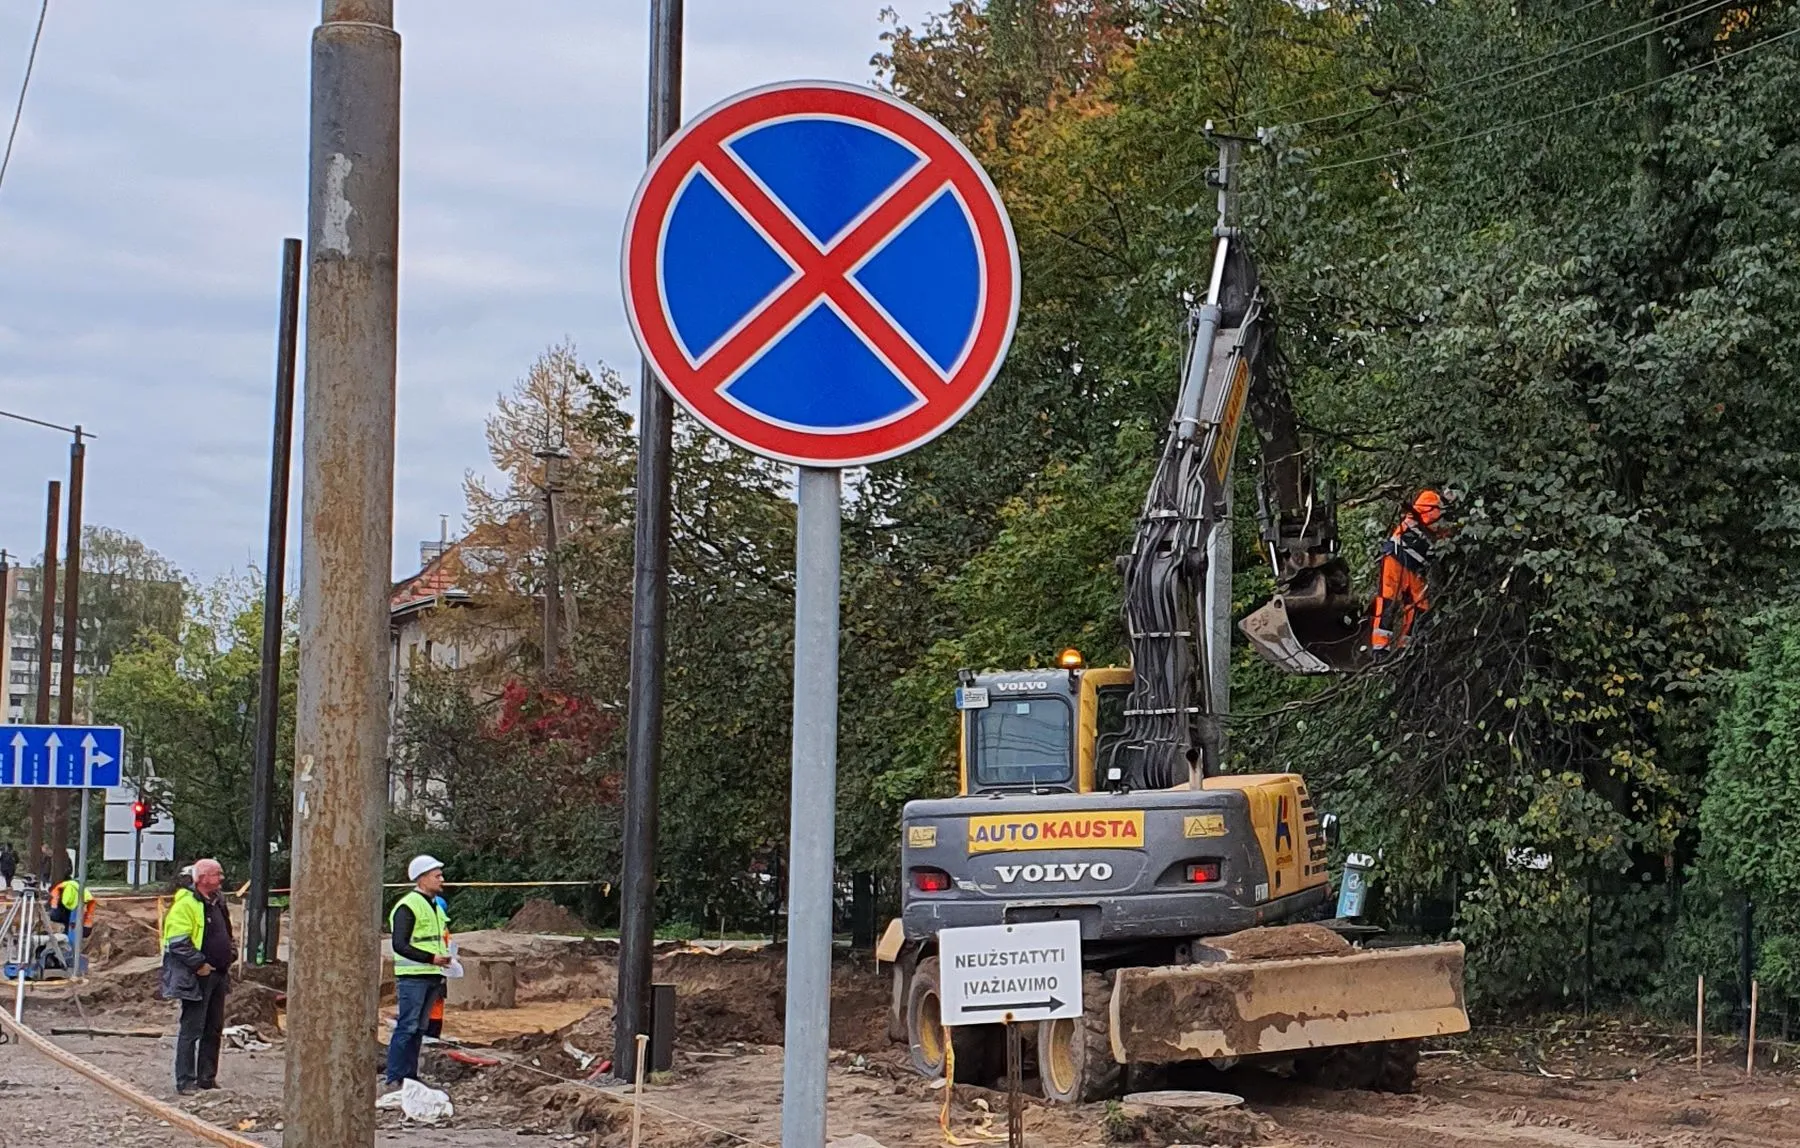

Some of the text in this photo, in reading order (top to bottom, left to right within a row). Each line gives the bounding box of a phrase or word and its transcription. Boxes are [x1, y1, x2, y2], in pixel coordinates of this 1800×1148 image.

[997, 681, 1048, 691] VOLVO
[994, 862, 1113, 883] VOLVO
[955, 948, 1065, 969] NEUŽSTATYTI
[964, 976, 1058, 999] ĮVAŽIAVIMO
